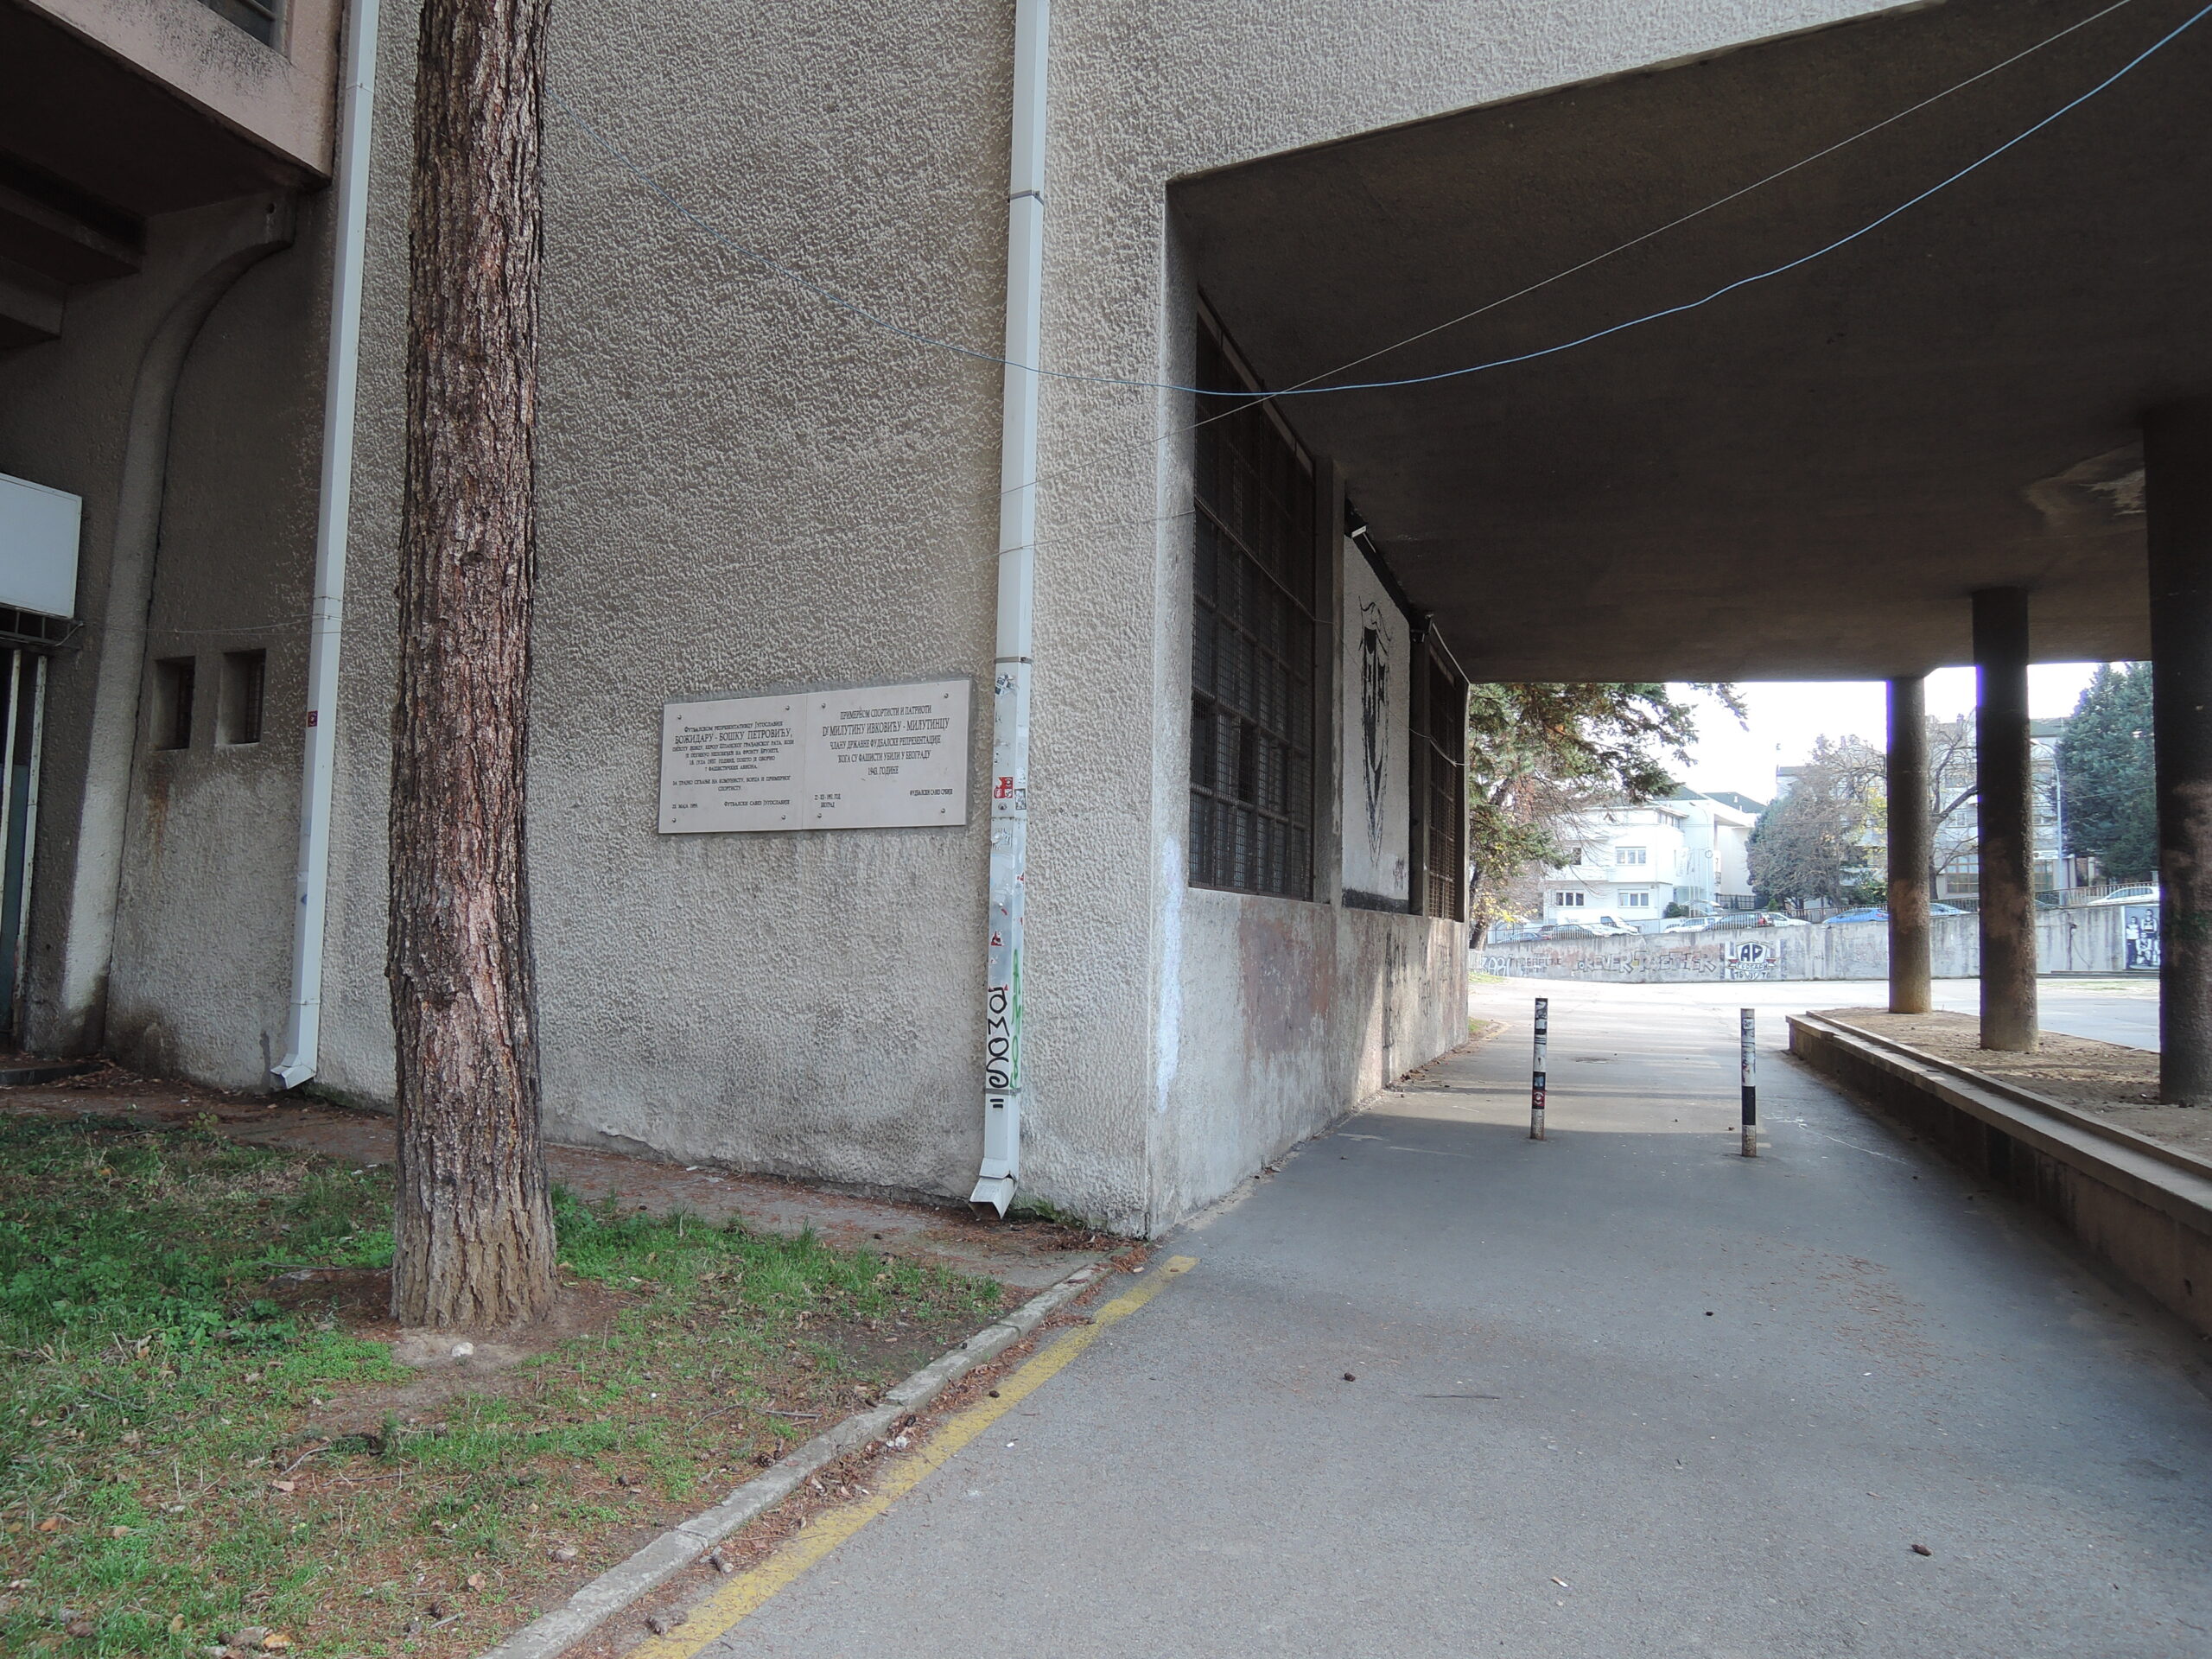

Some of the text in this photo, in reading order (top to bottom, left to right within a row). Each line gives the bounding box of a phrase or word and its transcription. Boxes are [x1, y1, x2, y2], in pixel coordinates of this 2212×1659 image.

[870, 707, 899, 718] СПОРТИСТИ
[906, 705, 932, 715] ПАТРИОТИ
[830, 723, 866, 736] МИЛУТИНУ
[867, 721, 902, 734] ИВКОВИЋУ
[906, 717, 950, 732] МИЛУТИНЦУ
[675, 734, 714, 744] БОЖИДАРУ
[719, 731, 745, 741] БОШКУ
[870, 737, 899, 748] ФУДБАЛСКЕ
[858, 753, 883, 762] ФАШИСТИ
[906, 749, 931, 760] БЕОГРАДУ
